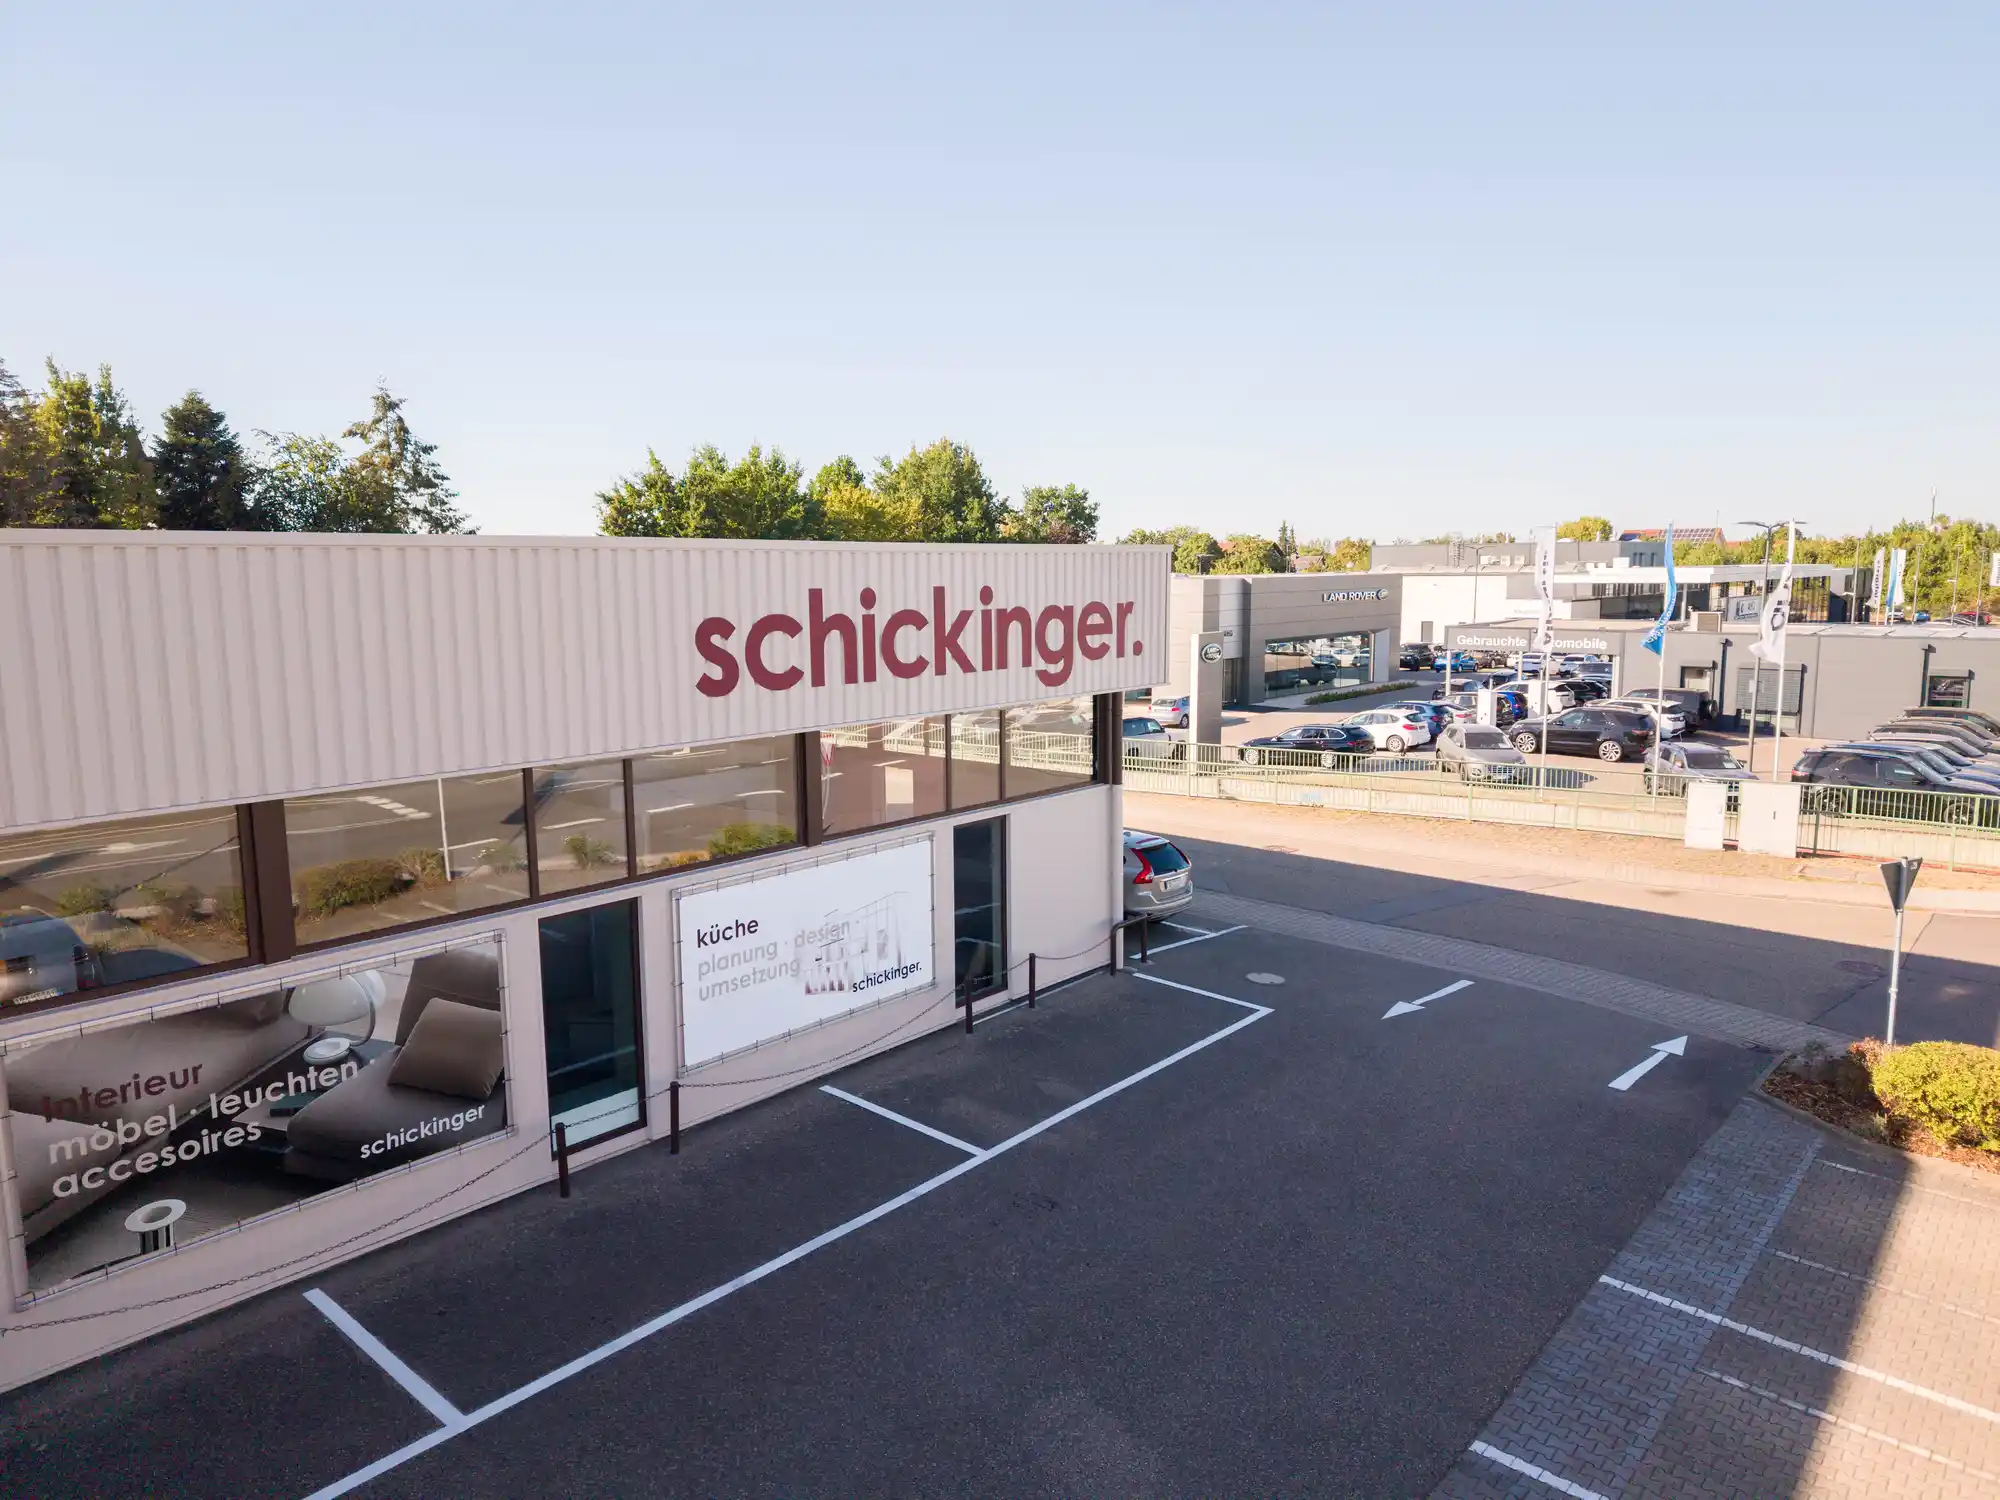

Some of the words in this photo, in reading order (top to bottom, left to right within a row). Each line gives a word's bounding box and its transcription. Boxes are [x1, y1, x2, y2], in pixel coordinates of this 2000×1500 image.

[1323, 592, 1348, 602] LAND
[1349, 591, 1376, 601] ROVER
[695, 585, 1143, 697] schickinger.
[1456, 635, 1527, 647] Gebrauchte
[696, 919, 759, 948] küche
[698, 940, 778, 981] planung
[794, 919, 850, 948] design
[699, 957, 800, 1001] umsetzung
[852, 961, 922, 992] schickinger.
[49, 1104, 176, 1164] möbel
[209, 1060, 358, 1119] leuchten
[360, 1104, 485, 1159] schickinger
[52, 1121, 262, 1198] accesoires
